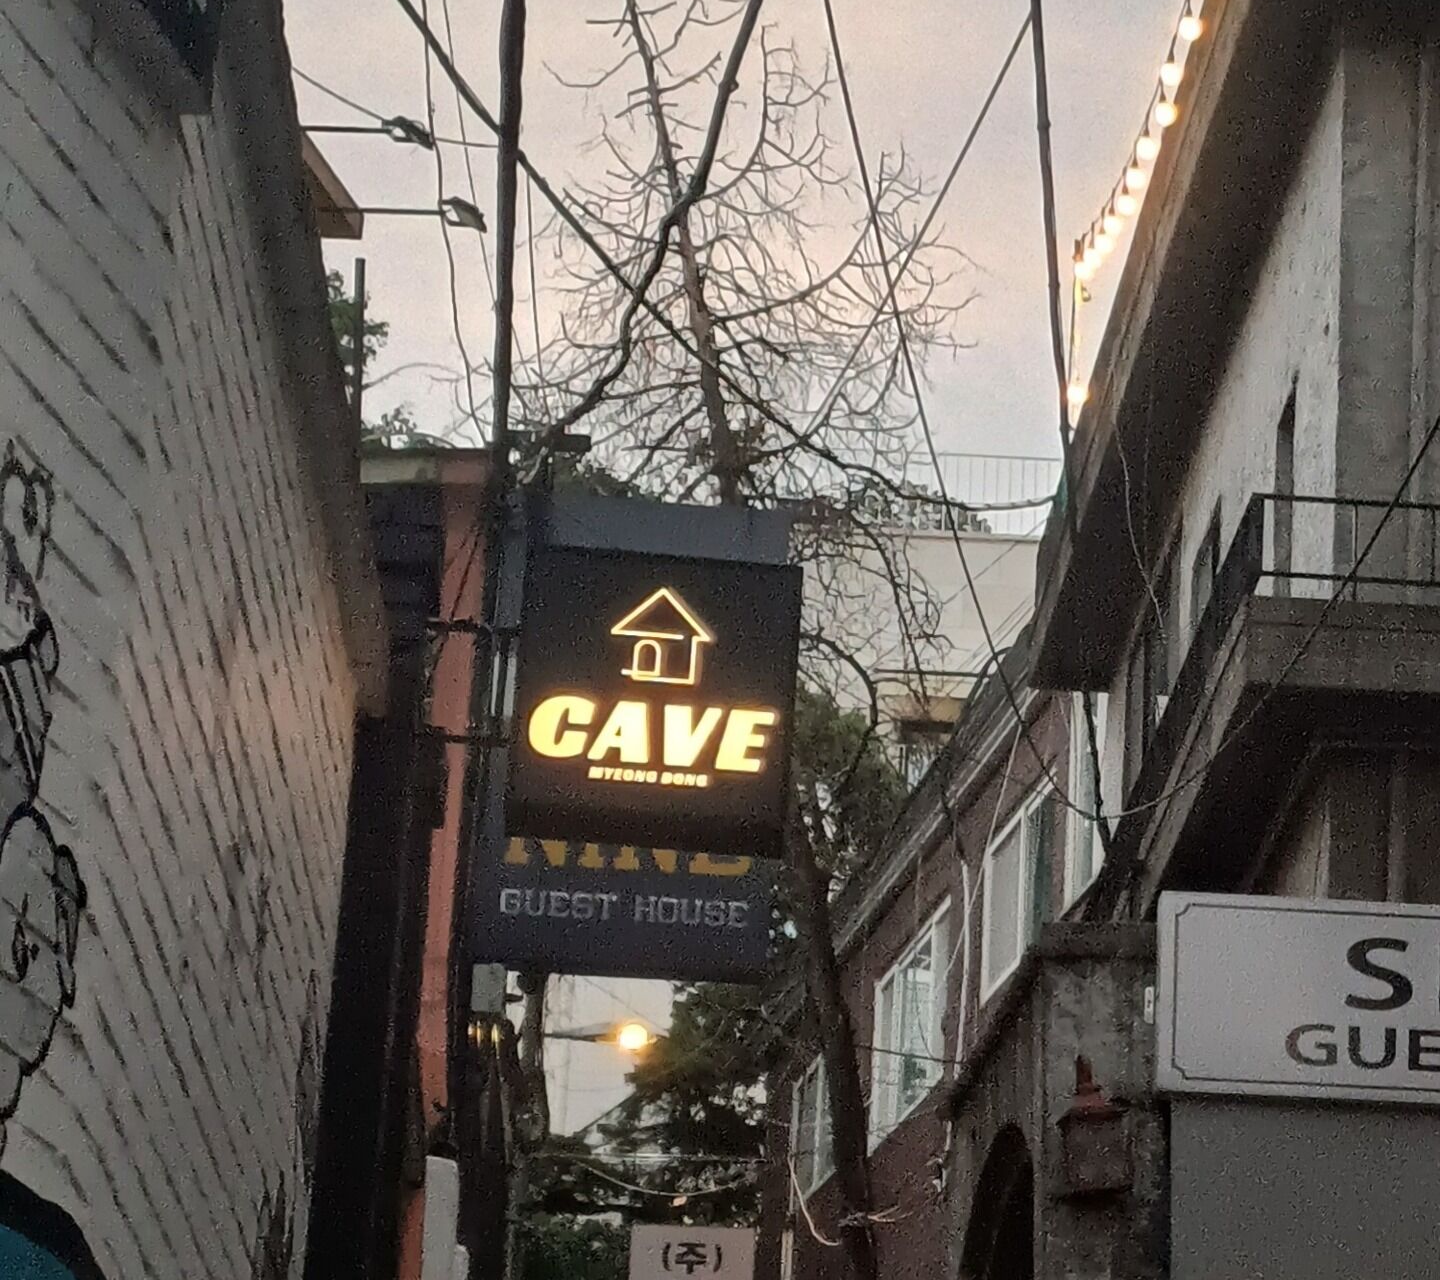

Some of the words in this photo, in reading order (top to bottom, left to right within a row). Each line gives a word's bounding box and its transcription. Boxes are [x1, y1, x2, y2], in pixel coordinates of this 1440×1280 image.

[528, 695, 776, 773] CAVE
[660, 771, 708, 788] DONG
[500, 887, 617, 921] GUEST
[634, 894, 750, 928] HOUSE
[661, 1242, 722, 1275] (주)
